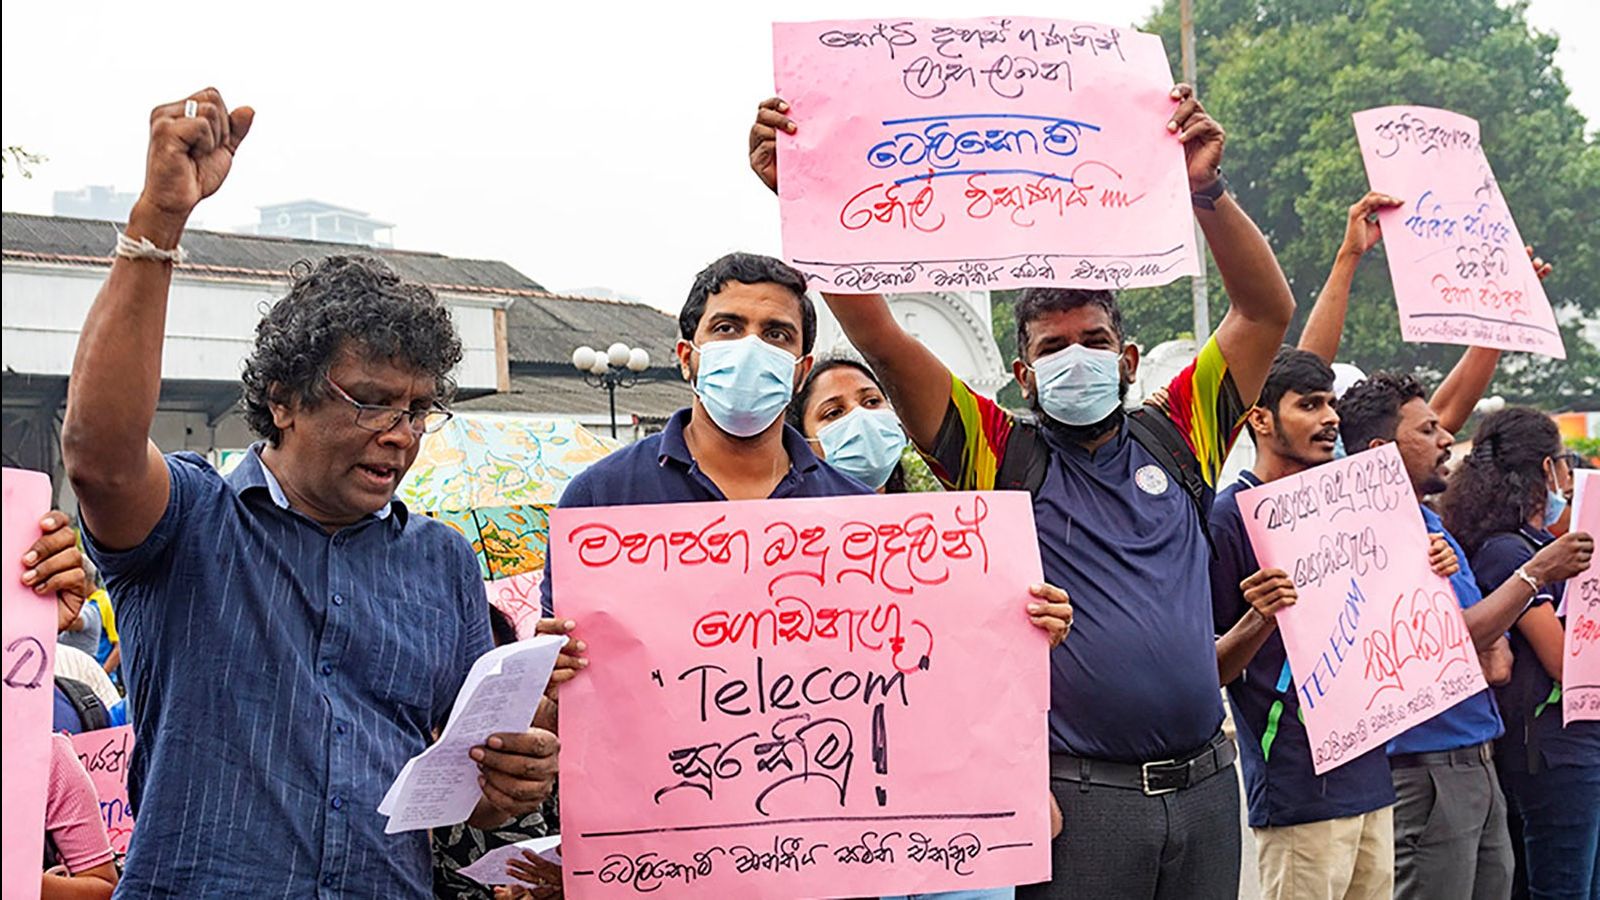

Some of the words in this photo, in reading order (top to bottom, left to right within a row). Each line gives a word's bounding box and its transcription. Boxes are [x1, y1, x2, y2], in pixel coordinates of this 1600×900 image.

[840, 168, 945, 232] රනිල්
[568, 514, 750, 574] මහජන
[764, 520, 831, 597] බදු
[836, 495, 989, 594] මුදලින්
[1299, 577, 1367, 709] TELECOM
